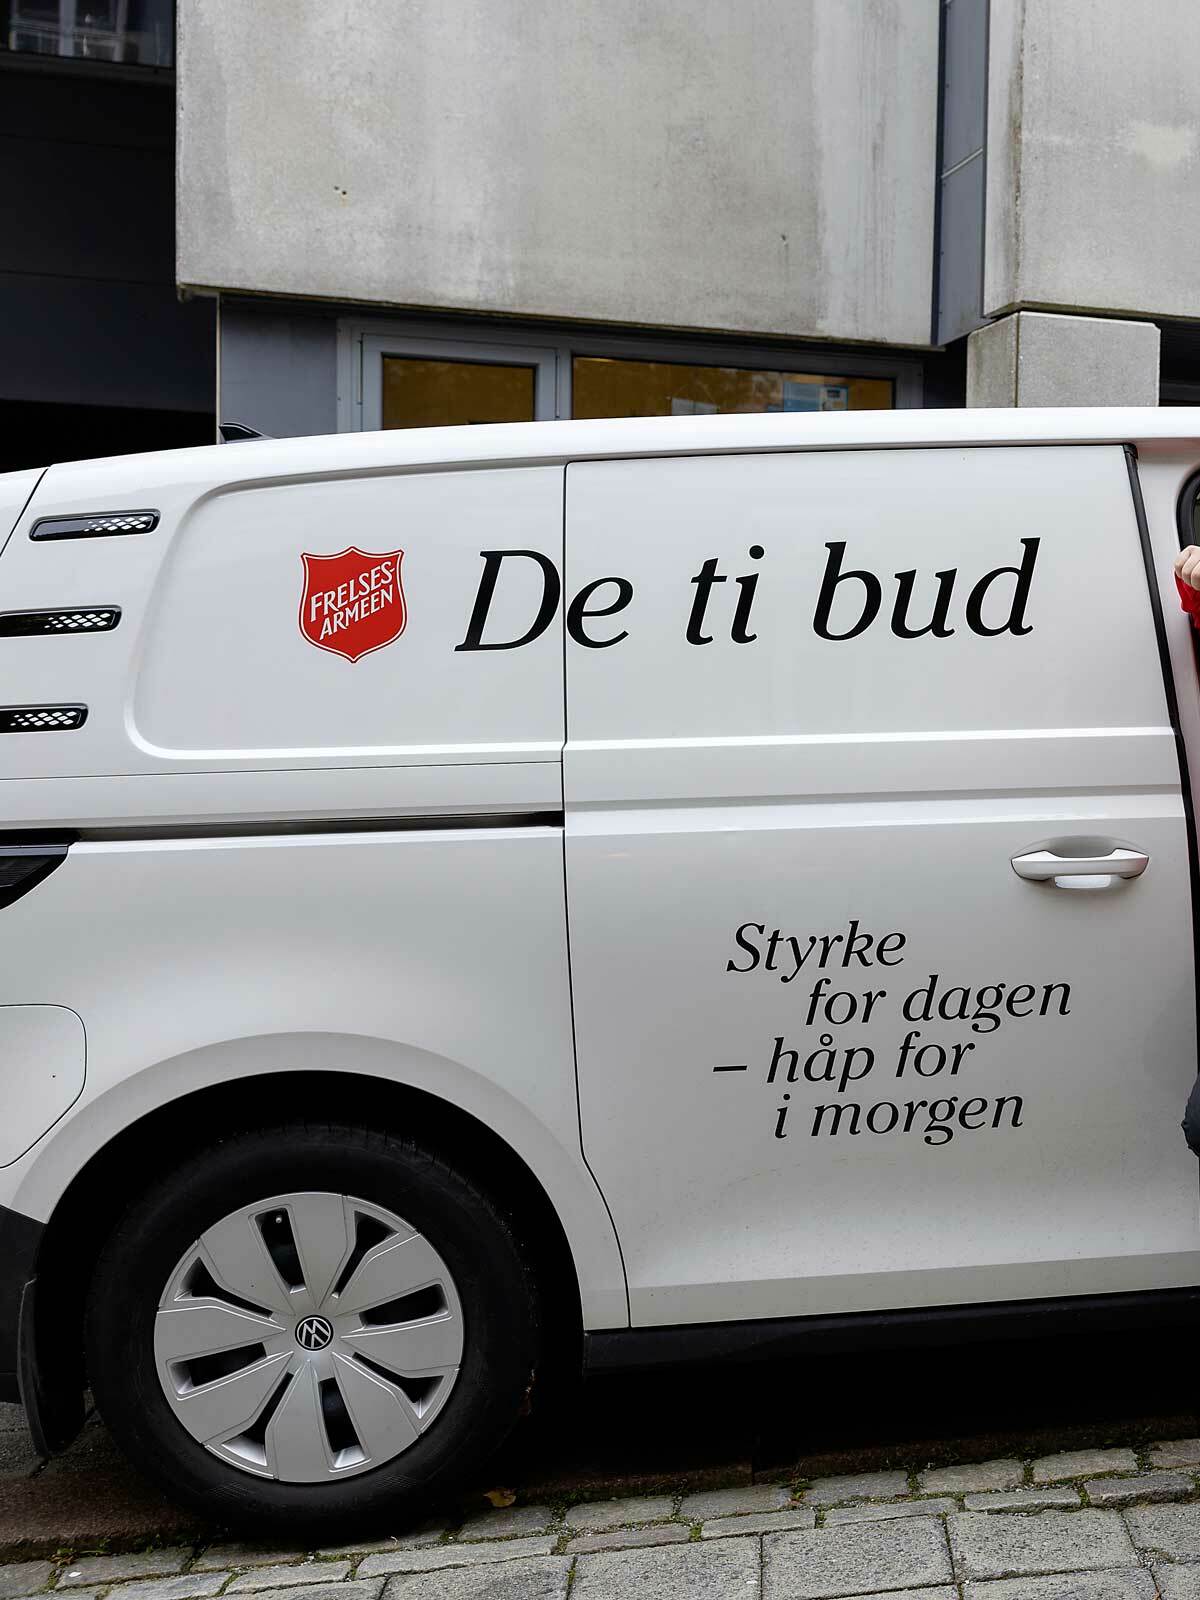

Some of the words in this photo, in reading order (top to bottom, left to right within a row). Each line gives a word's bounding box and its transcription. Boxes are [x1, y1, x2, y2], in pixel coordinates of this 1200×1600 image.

[310, 561, 395, 622] FRELSES-
[319, 584, 393, 640] ARMEEN
[454, 549, 634, 651] De
[685, 545, 765, 646] ti
[812, 537, 1041, 641] bud
[726, 920, 907, 983] Styrke
[805, 978, 887, 1025] for
[902, 974, 1071, 1033] dagen
[767, 1033, 875, 1092] håp
[896, 1031, 975, 1077] for
[774, 1093, 791, 1139] i
[811, 1094, 1023, 1145] morgen
